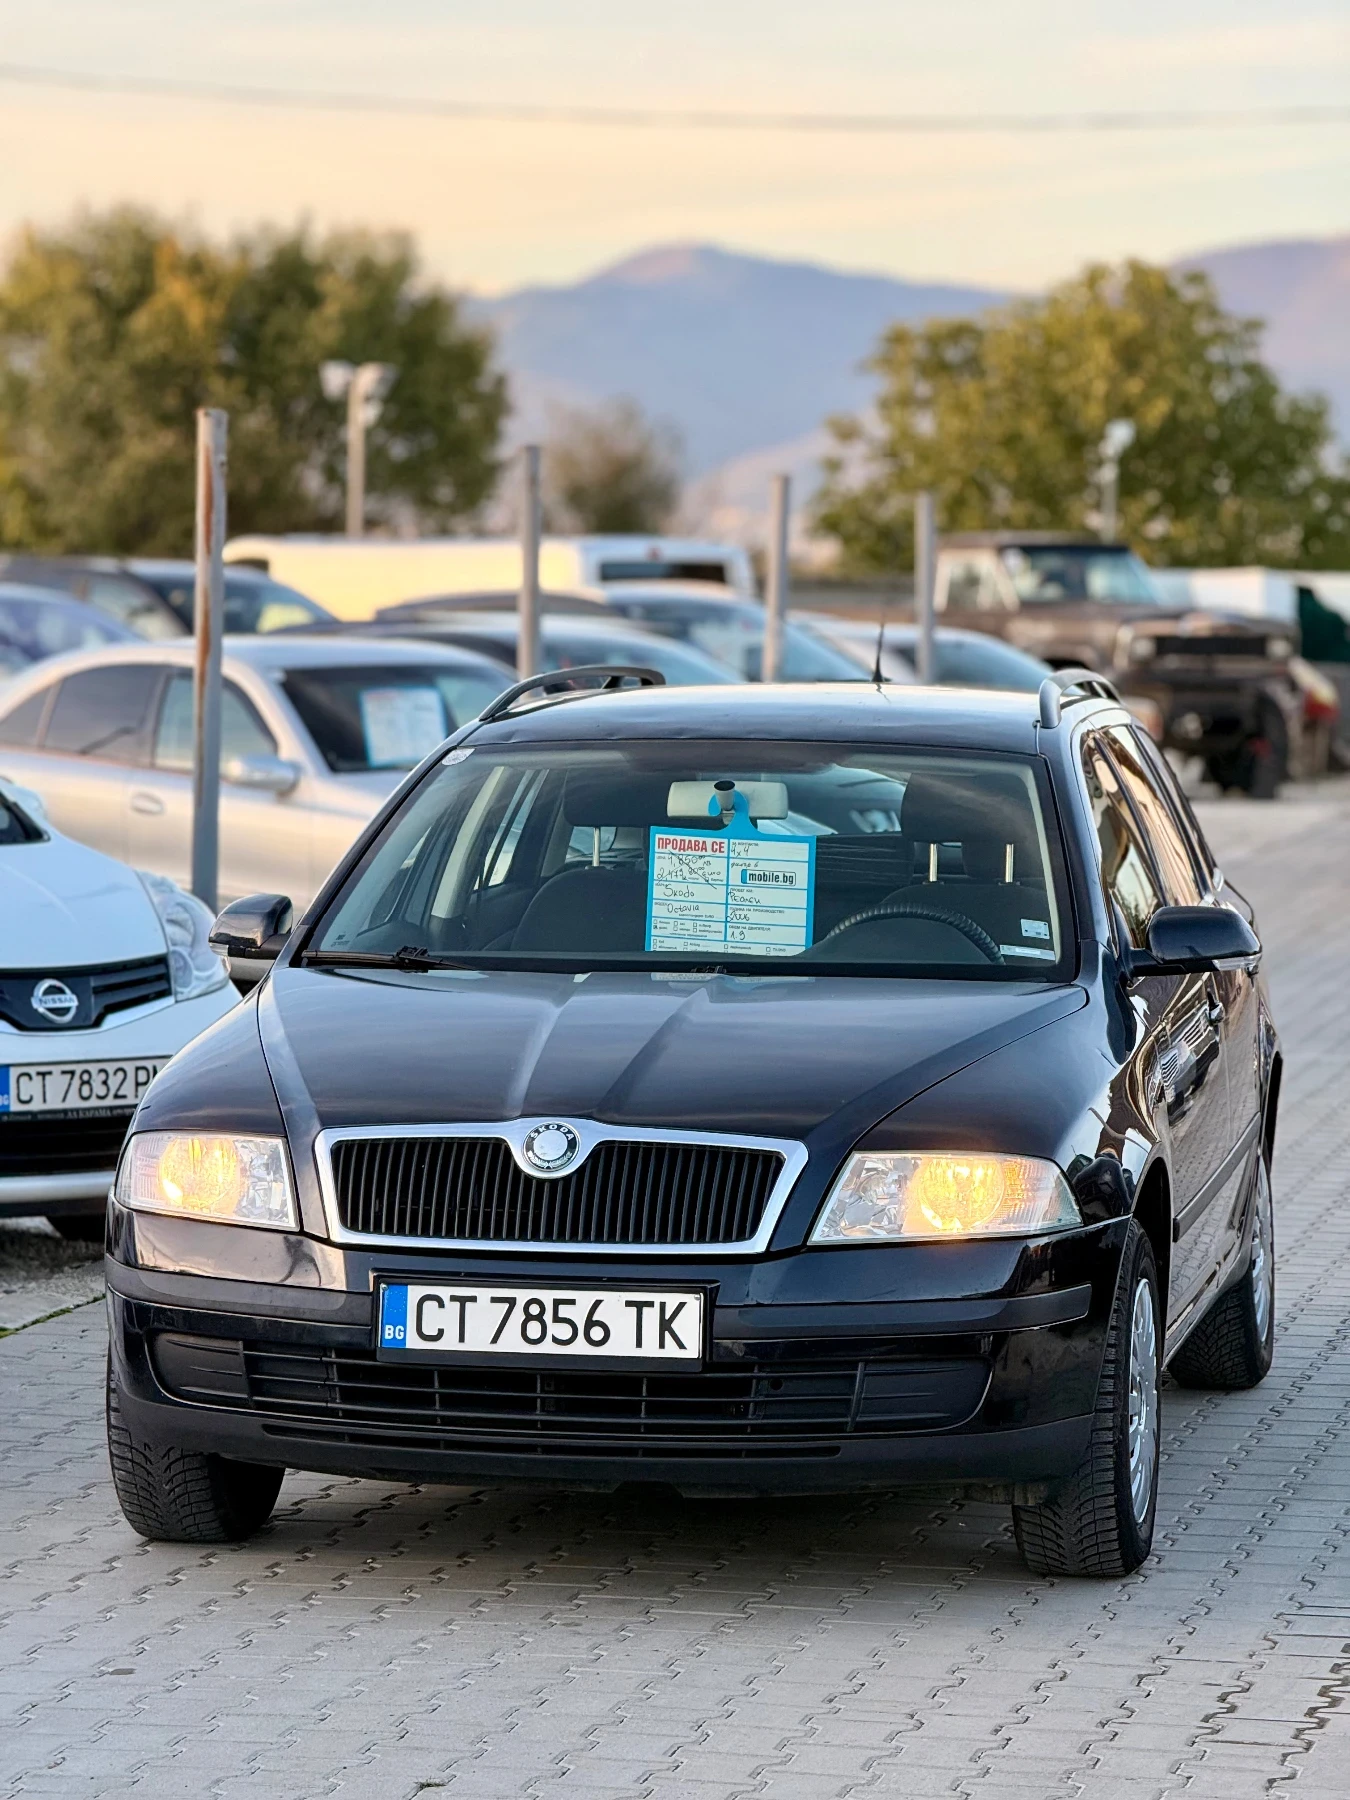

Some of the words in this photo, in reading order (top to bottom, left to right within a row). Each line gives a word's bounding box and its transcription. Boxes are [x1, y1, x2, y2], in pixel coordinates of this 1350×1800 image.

[657, 837, 708, 852] ПРОДАВА
[711, 841, 725, 853] СЕ
[748, 872, 794, 885] mobile.bg
[667, 903, 700, 914] Octavia
[39, 996, 75, 1005] NISSAN
[16, 1069, 52, 1104] CT
[61, 1066, 128, 1103] 7832
[415, 1293, 478, 1343] CT
[489, 1296, 612, 1348] 7856
[624, 1300, 688, 1350] TK
[384, 1324, 405, 1340] BG
